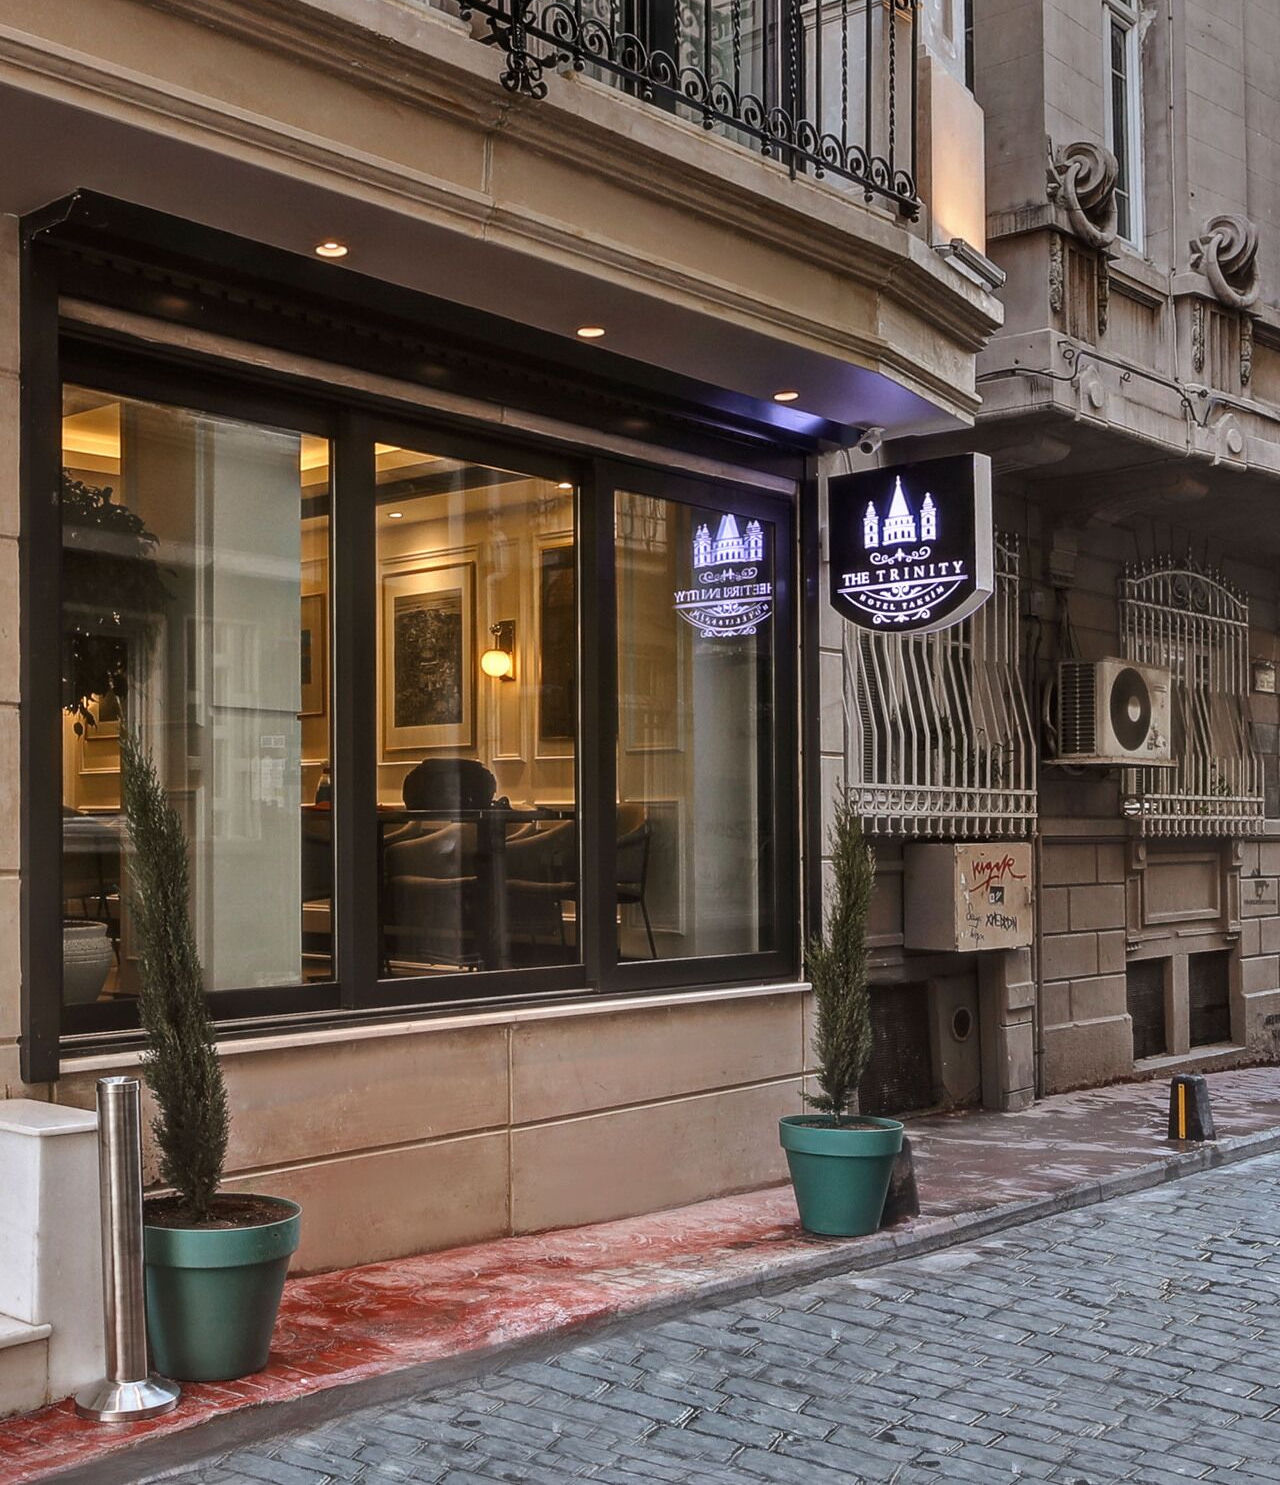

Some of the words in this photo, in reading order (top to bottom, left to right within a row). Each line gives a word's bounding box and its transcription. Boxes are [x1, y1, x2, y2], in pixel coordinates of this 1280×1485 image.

[842, 571, 870, 587] THE
[876, 560, 964, 582] TRINITY
[859, 593, 896, 610] HOTEL
[902, 585, 945, 610] TAKSİM
